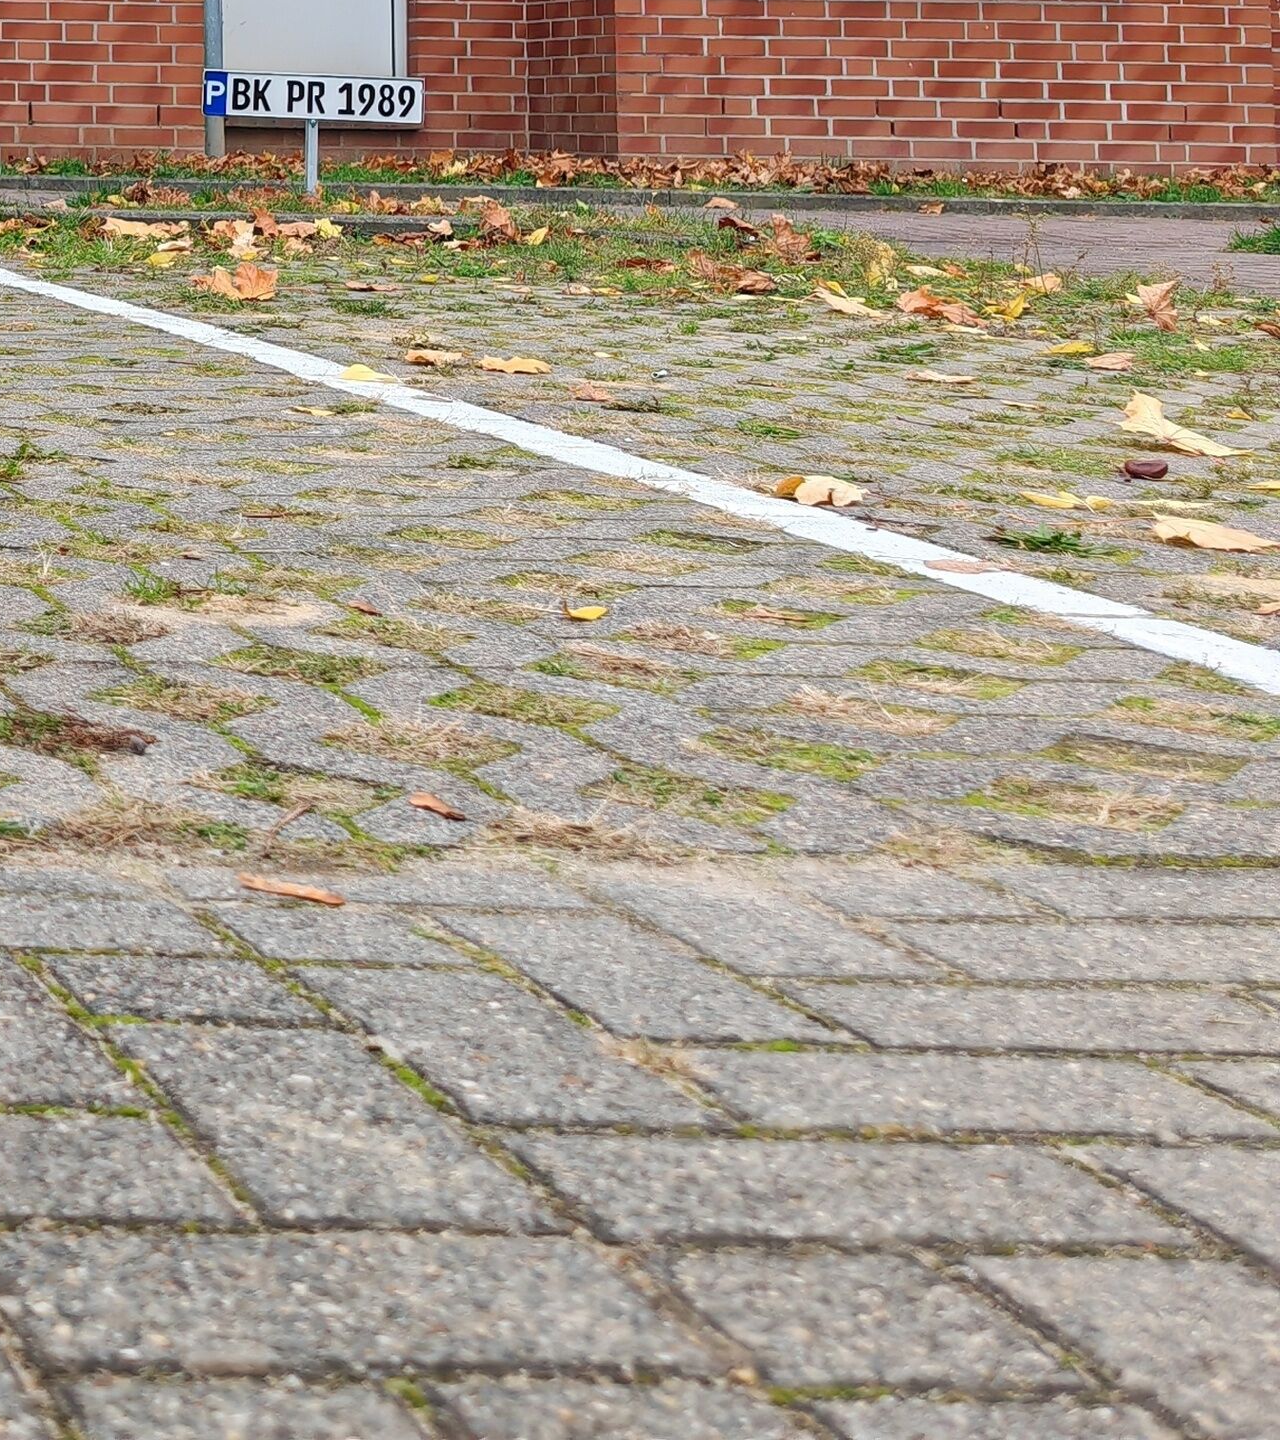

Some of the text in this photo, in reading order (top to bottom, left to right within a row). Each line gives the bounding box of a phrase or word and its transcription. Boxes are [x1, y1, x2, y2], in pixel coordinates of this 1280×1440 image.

[206, 78, 416, 117] P BK PR 1989
